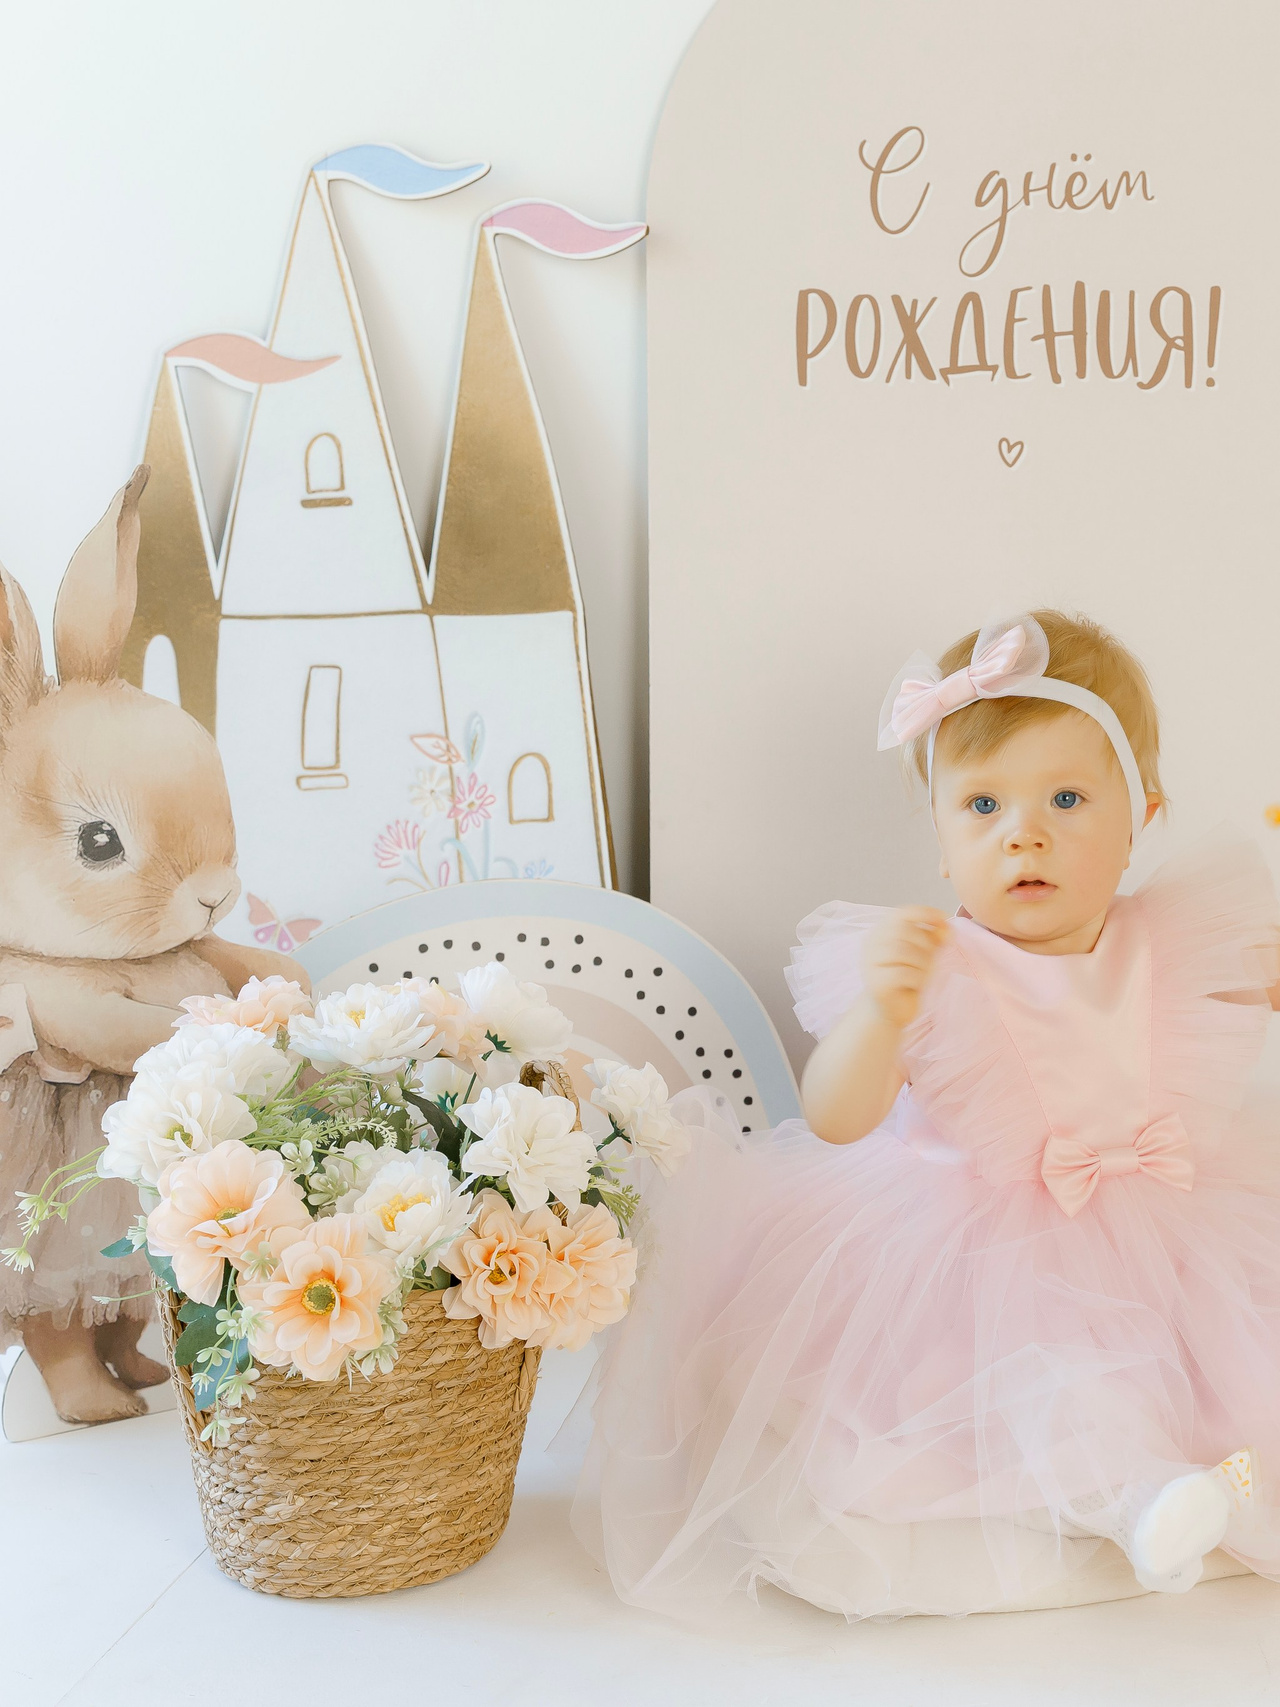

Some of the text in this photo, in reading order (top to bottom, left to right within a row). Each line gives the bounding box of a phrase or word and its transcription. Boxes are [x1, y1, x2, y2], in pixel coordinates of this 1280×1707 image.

[858, 126, 1155, 278] С днём
[796, 280, 1221, 390] РОЖДЕНИЯ!
